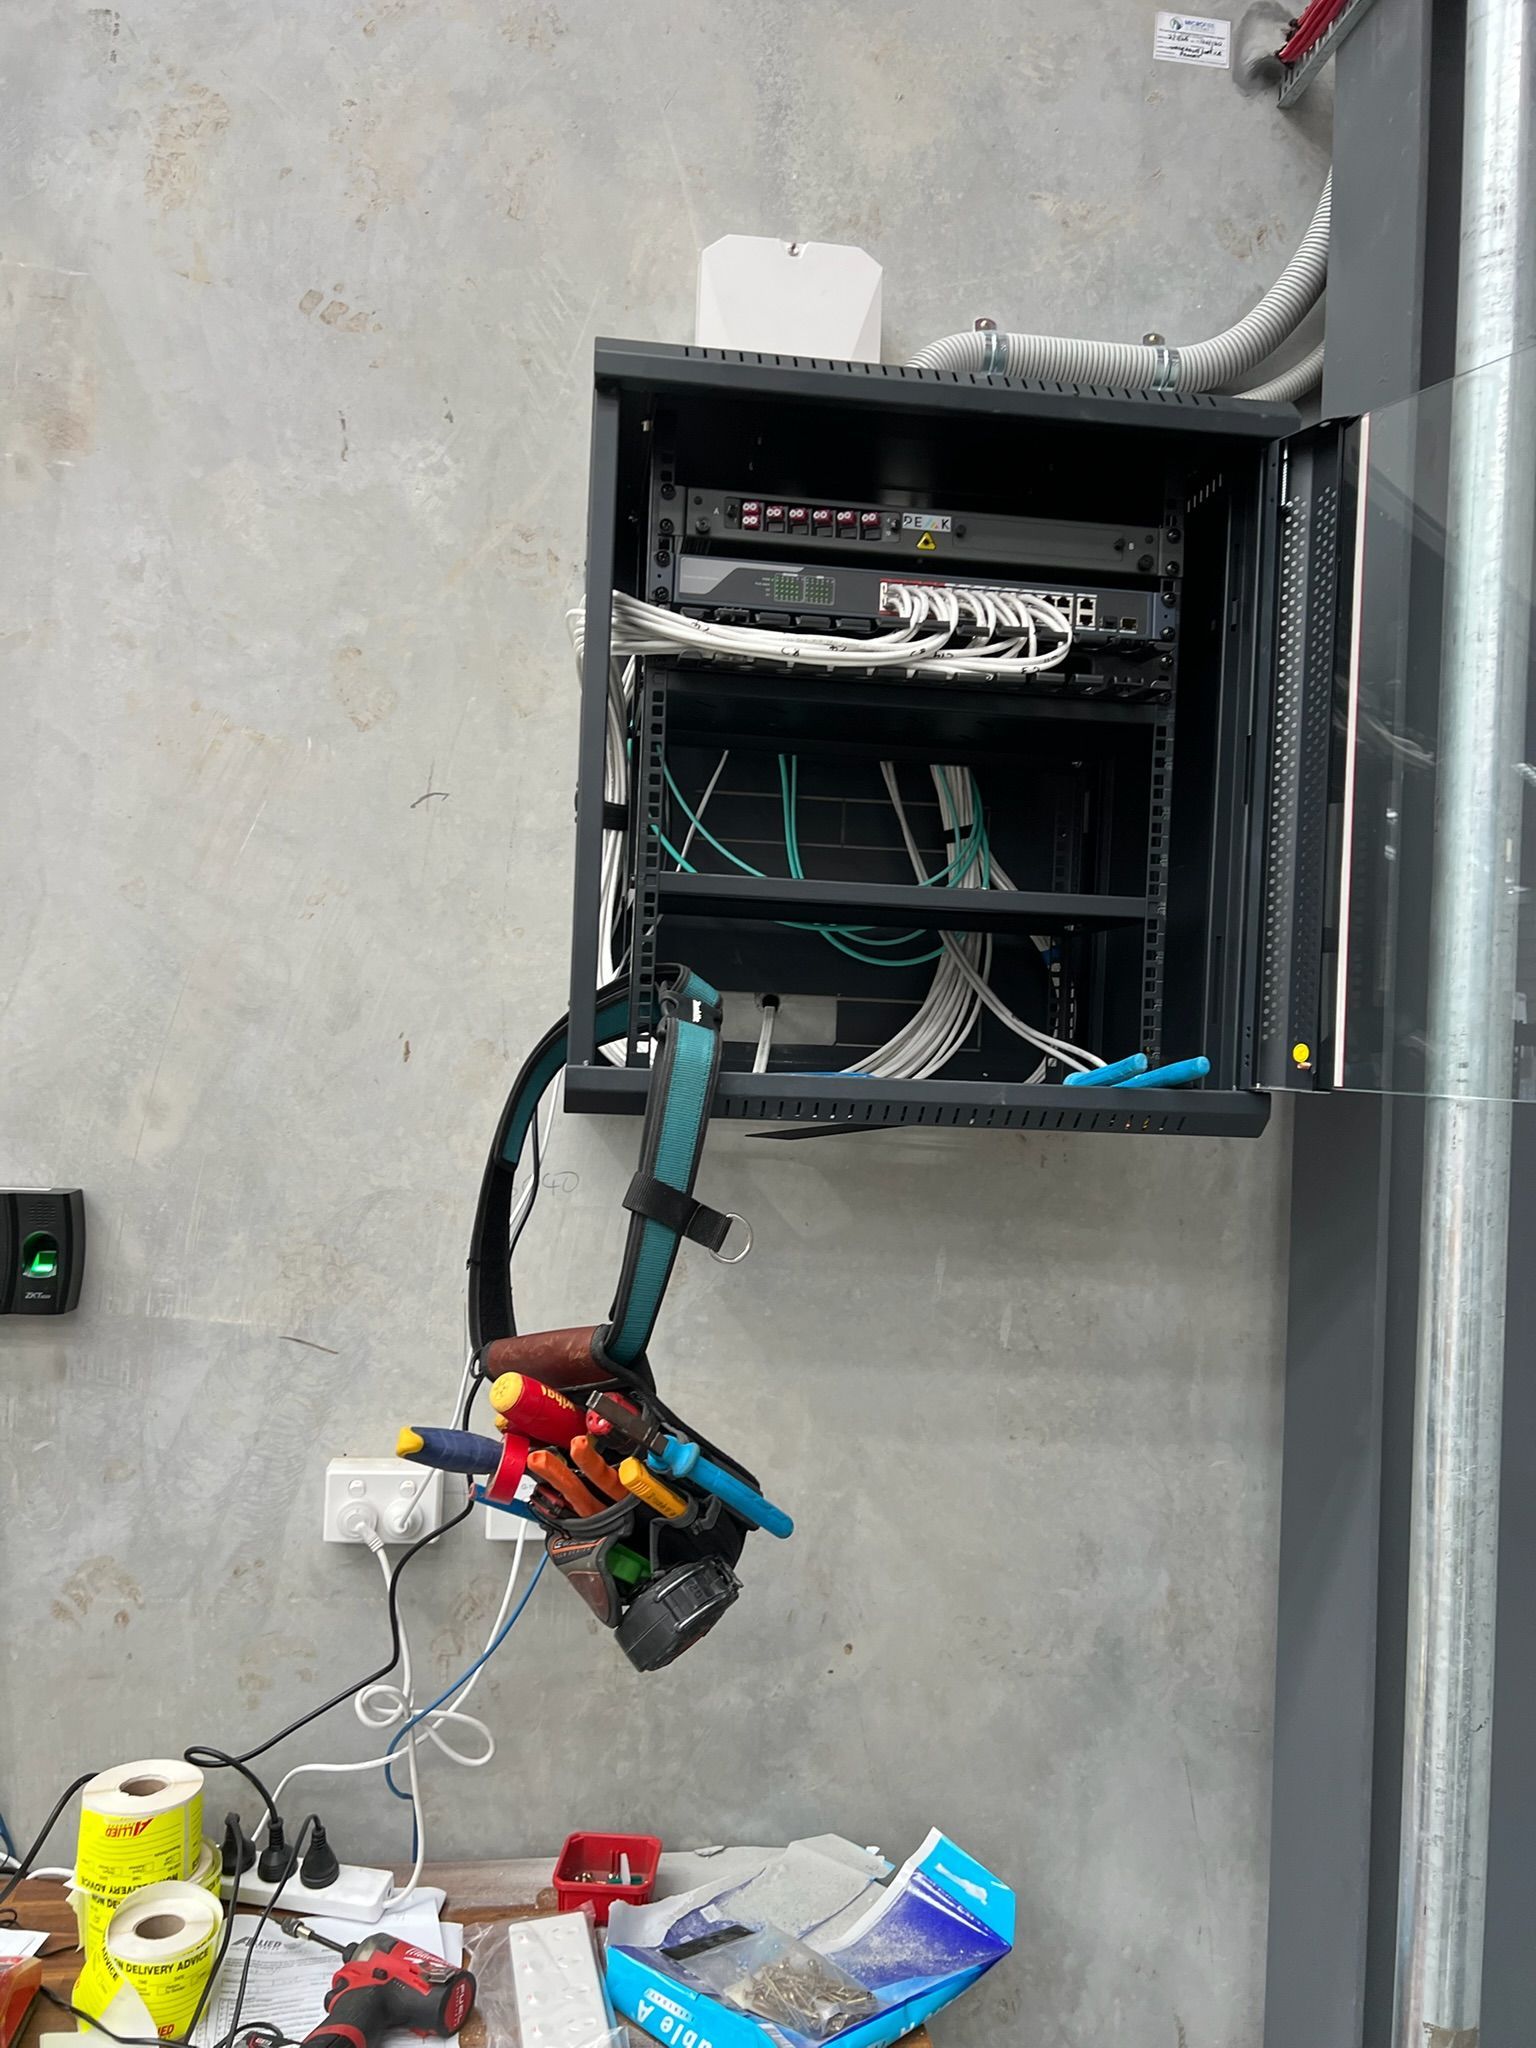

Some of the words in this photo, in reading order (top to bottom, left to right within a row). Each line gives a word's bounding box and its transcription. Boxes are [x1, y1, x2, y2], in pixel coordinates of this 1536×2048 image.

[105, 1817, 155, 1838] ALLIED
[125, 1964, 175, 1976] DELIVERY
[176, 1947, 210, 1972] ADVICE
[636, 1999, 656, 2024] A
